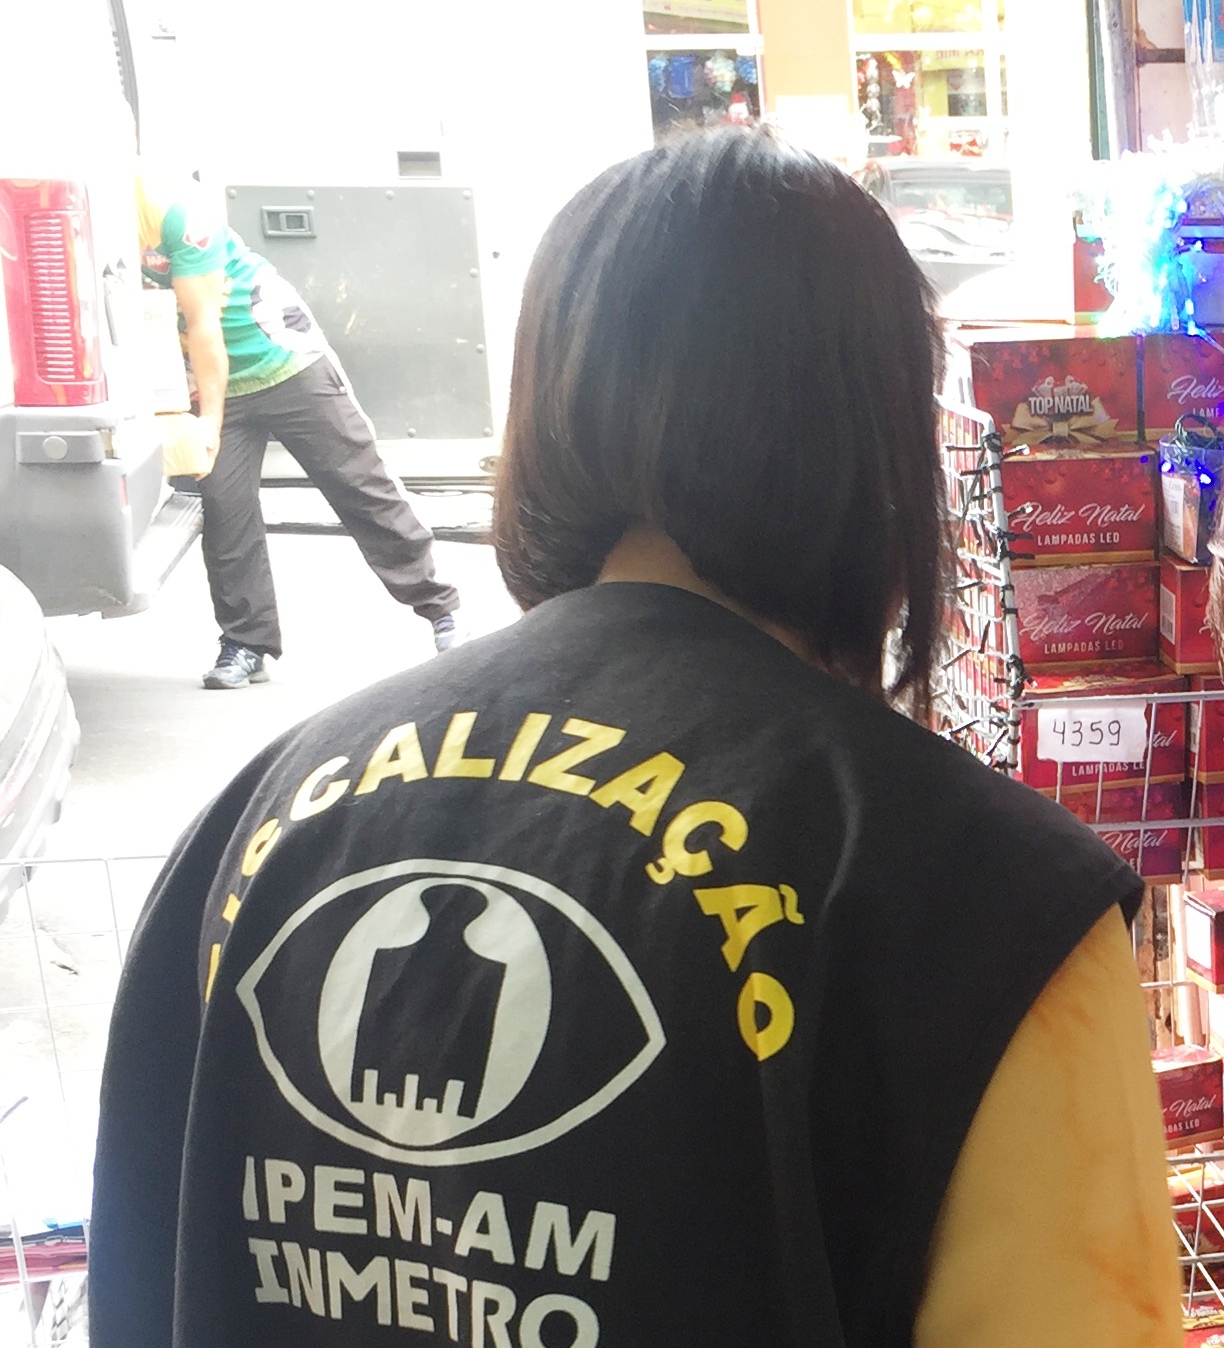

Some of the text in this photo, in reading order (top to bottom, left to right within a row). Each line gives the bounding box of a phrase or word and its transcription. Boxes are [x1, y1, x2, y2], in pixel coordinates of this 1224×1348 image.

[1028, 394, 1094, 415] TOP NATAL
[1011, 502, 1145, 532] Feliz Natal
[1037, 531, 1120, 547] LAMPADAS LED
[1019, 611, 1149, 642] Feliz Natal
[1044, 639, 1125, 655] LAMPADAS LED
[1053, 719, 1122, 747] 4359
[1169, 1094, 1217, 1118] Natal
[1185, 1118, 1200, 1129] LED
[242, 1155, 617, 1282] IPEM-AM
